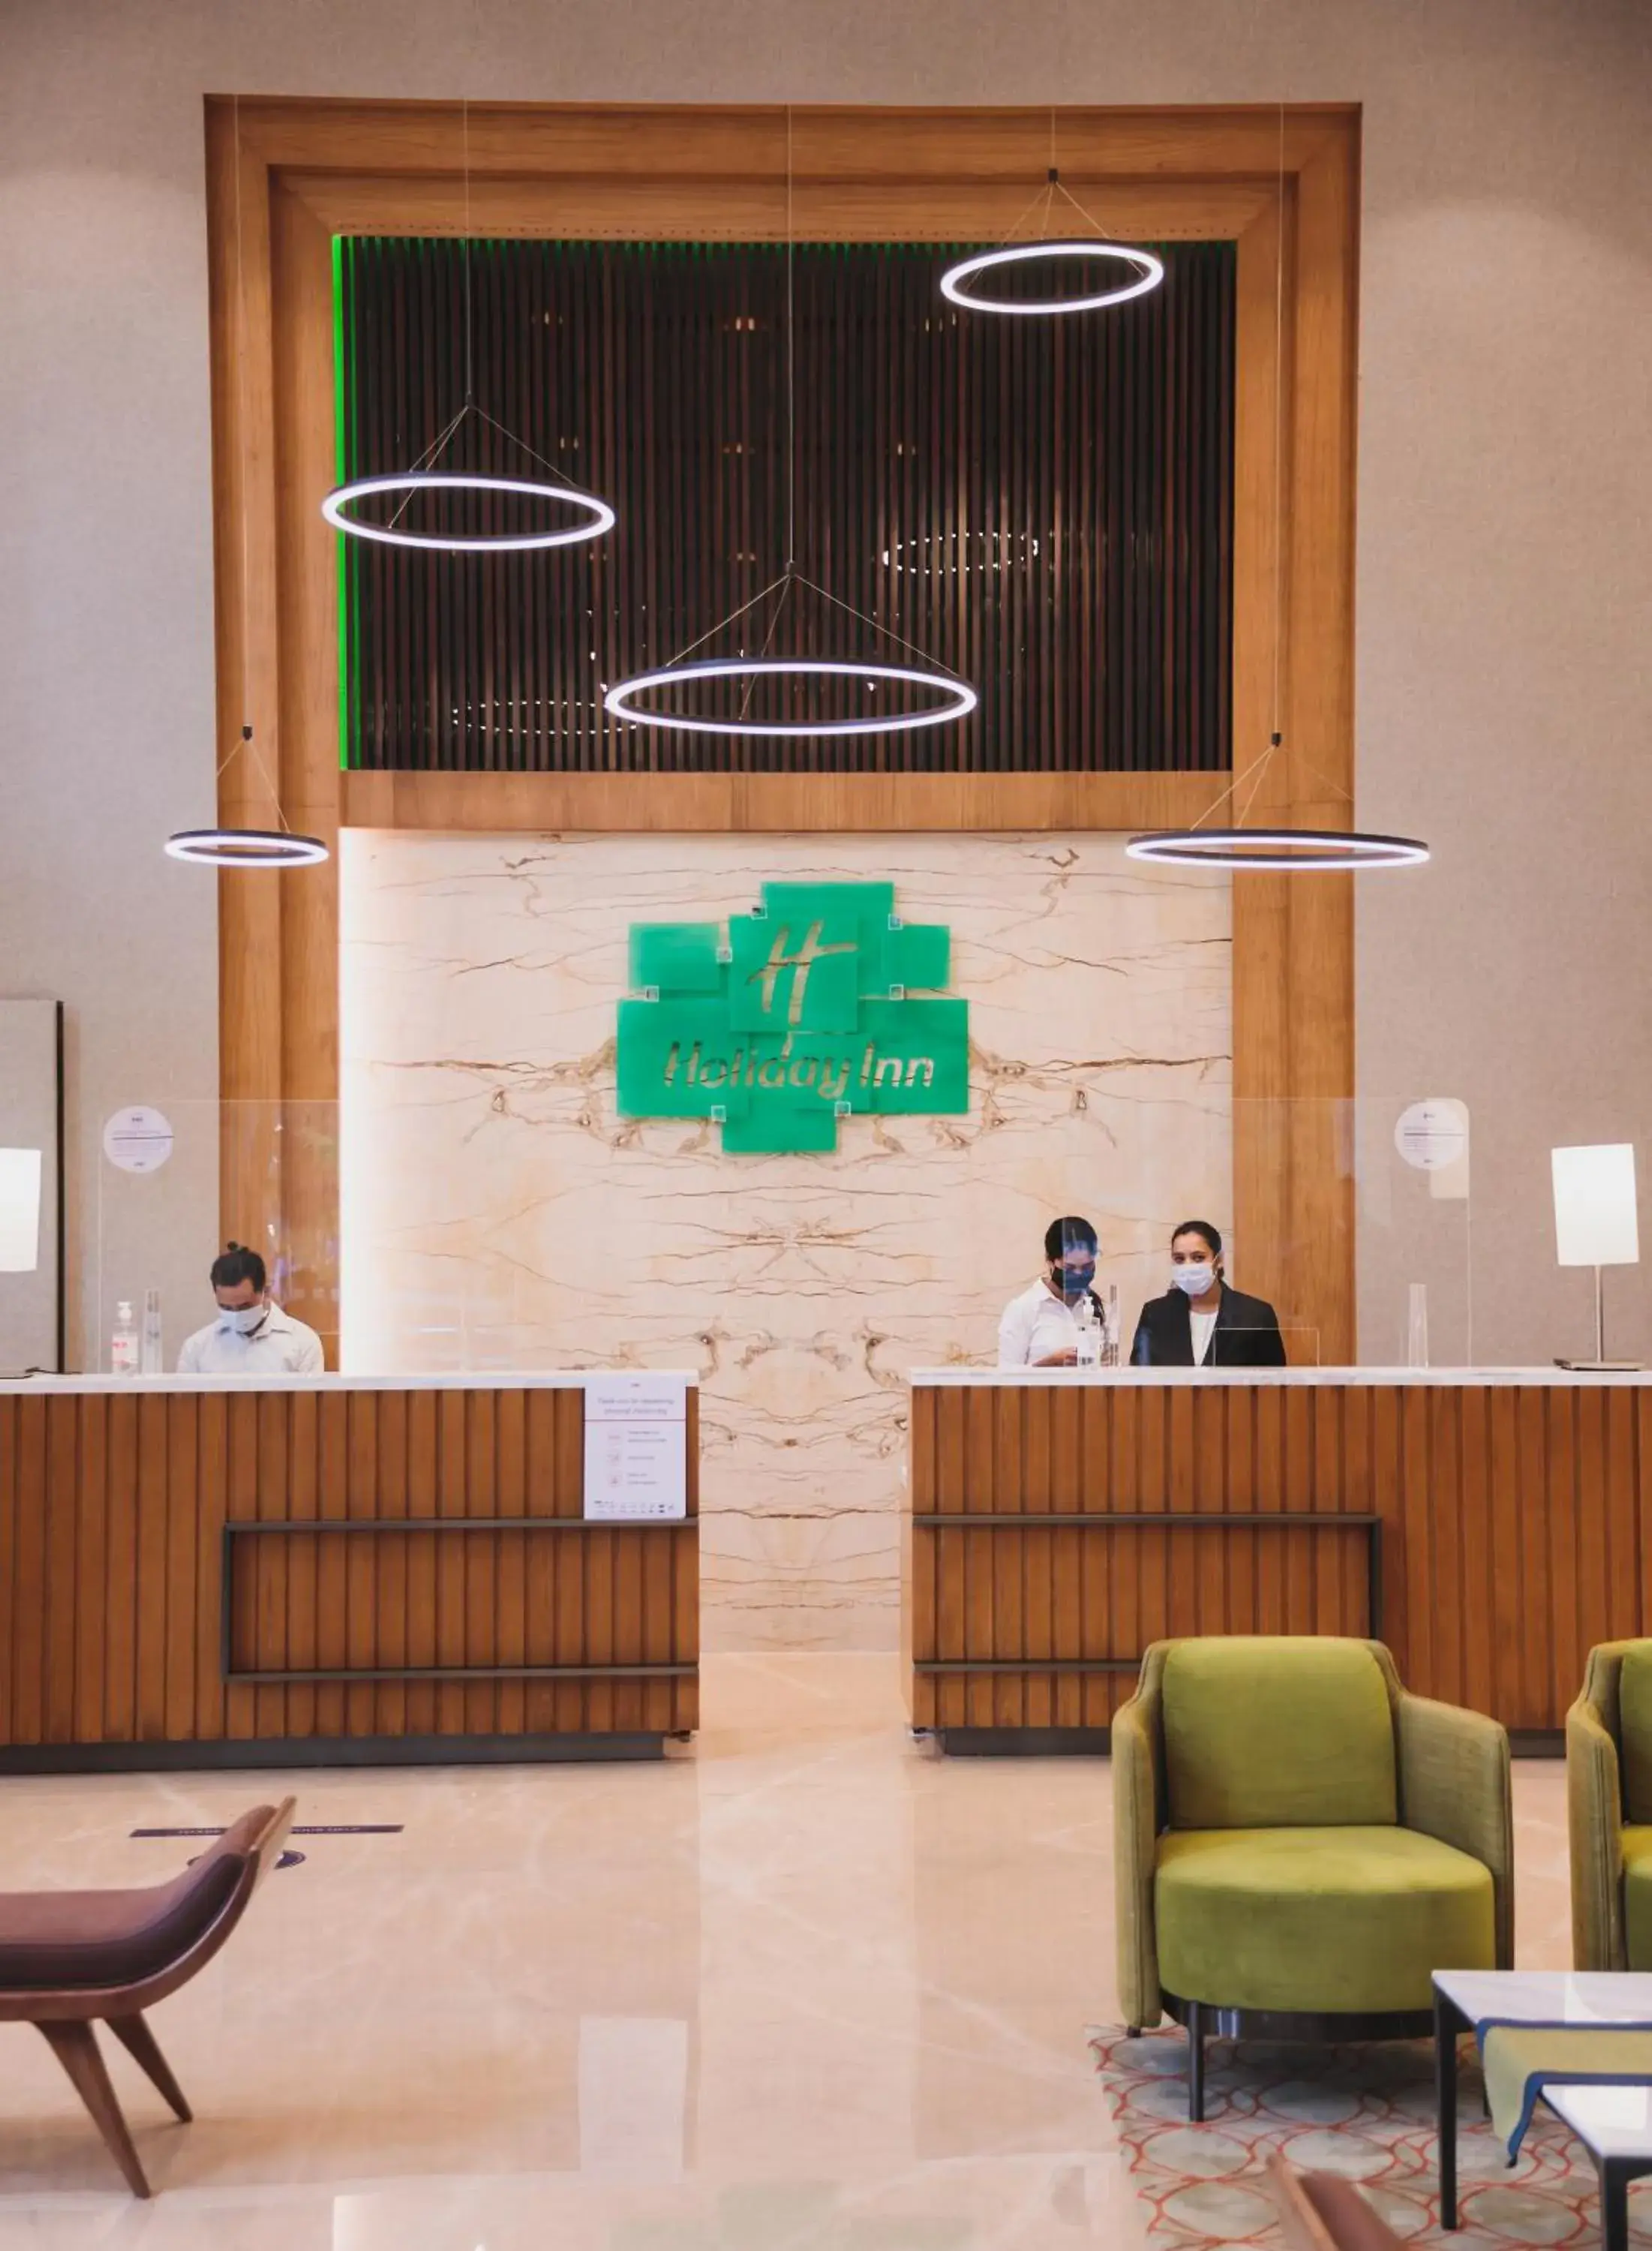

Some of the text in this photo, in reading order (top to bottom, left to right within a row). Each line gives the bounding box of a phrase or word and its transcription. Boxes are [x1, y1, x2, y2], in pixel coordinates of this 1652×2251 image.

[745, 919, 858, 1026] H
[664, 1032, 935, 1098] Holiday Inn
